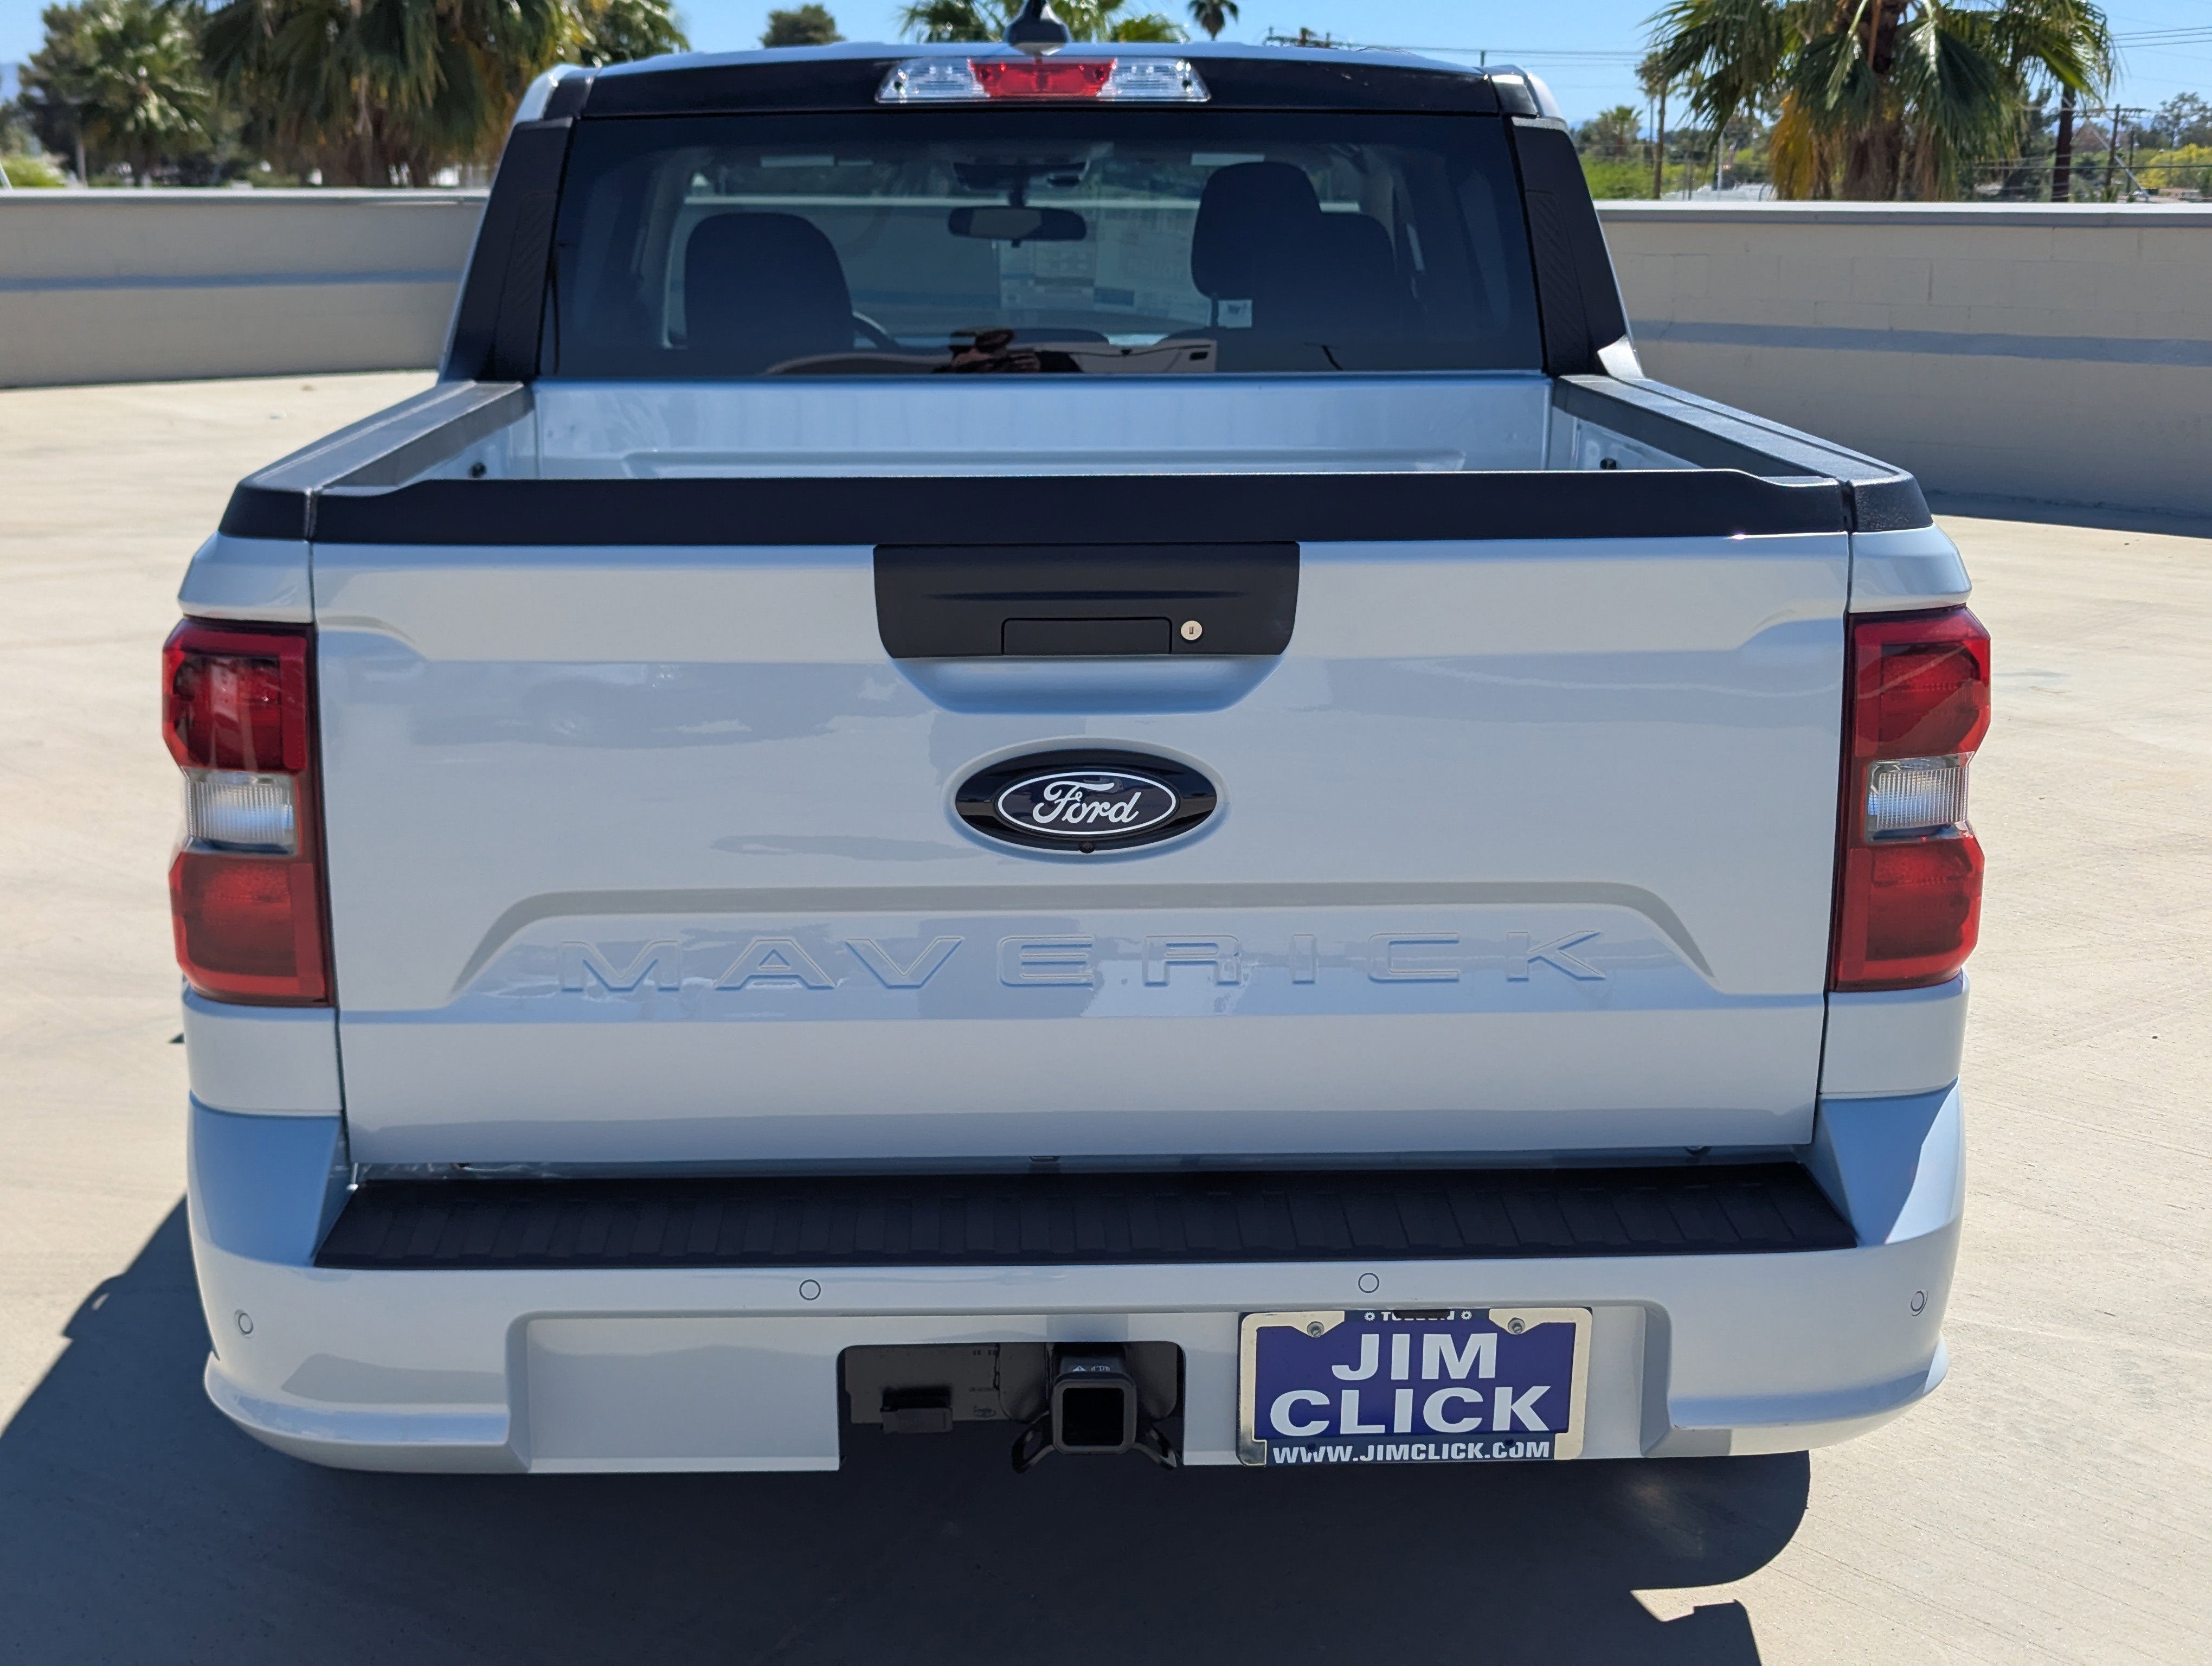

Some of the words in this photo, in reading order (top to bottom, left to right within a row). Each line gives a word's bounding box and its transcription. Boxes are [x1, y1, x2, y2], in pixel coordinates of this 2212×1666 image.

[1032, 780, 1142, 823] Ford
[560, 930, 1606, 992] MAVERICK
[1331, 1332, 1498, 1381] JIM
[1270, 1385, 1551, 1437] CLICK
[1272, 1441, 1551, 1464] WWW.JIMCLICK.COM
